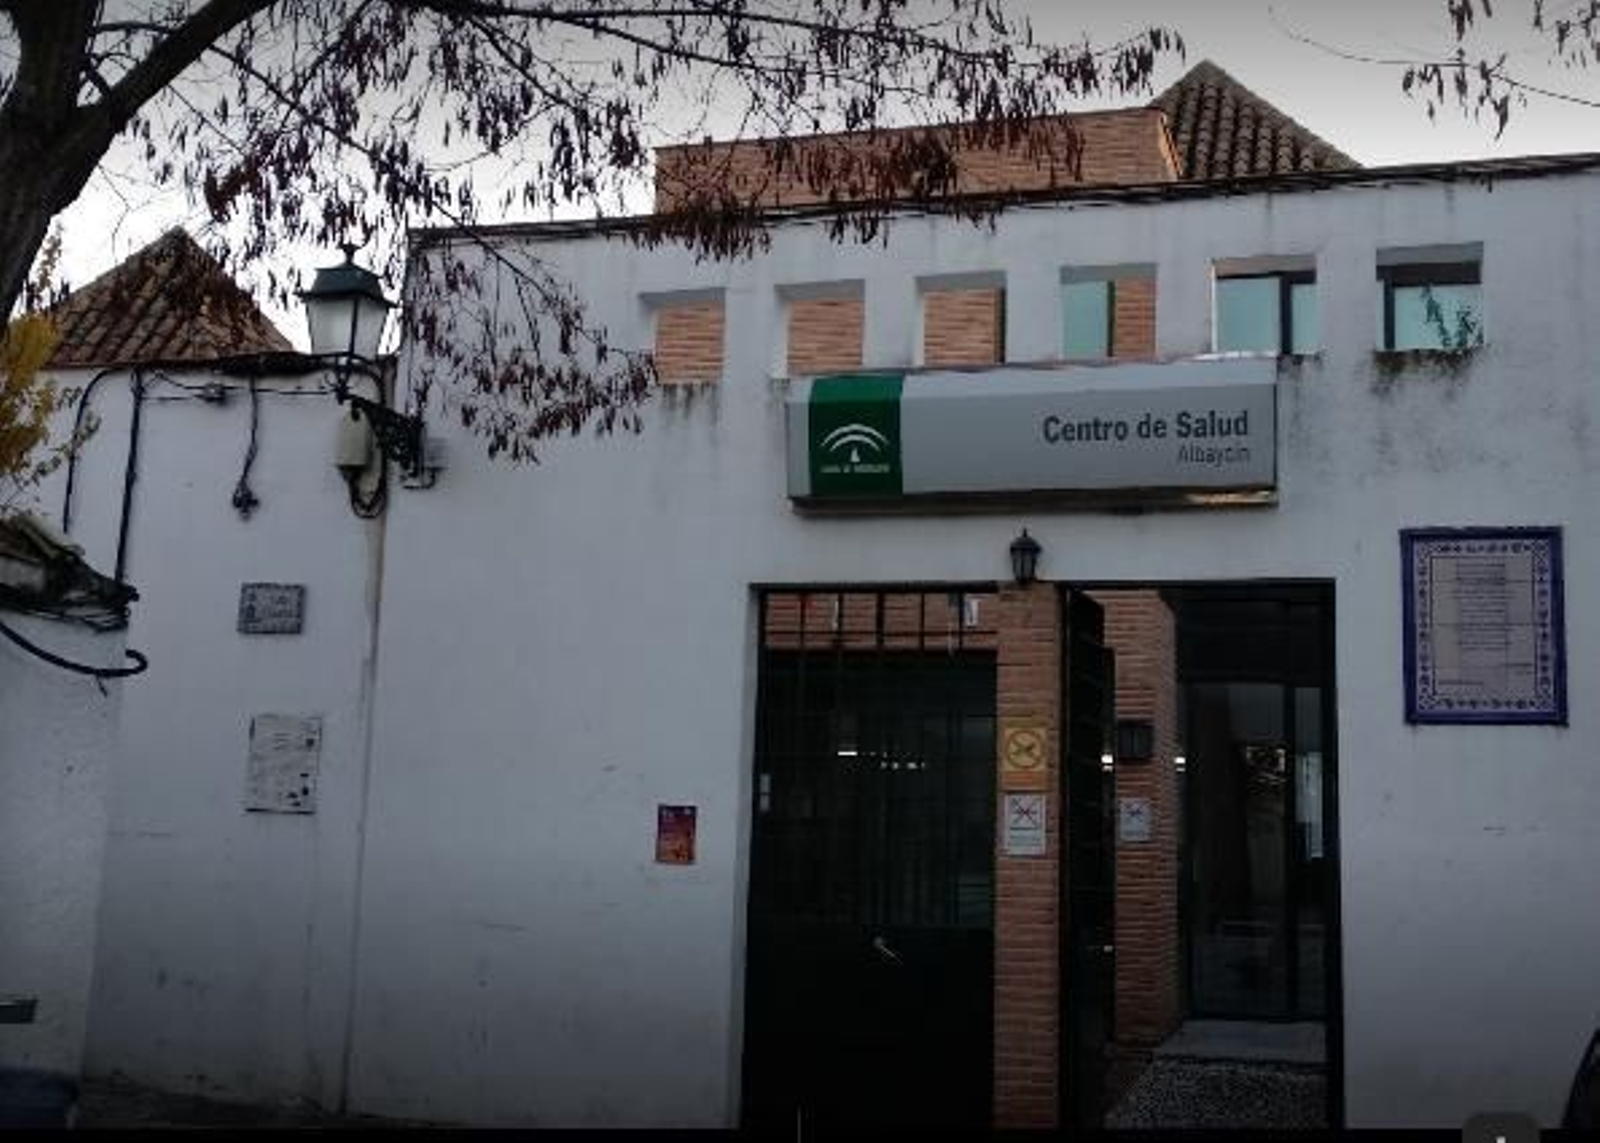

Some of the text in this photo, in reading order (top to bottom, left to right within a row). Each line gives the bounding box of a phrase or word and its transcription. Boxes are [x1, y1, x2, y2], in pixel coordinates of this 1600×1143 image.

[1043, 410, 1249, 444] Centro de Salud
